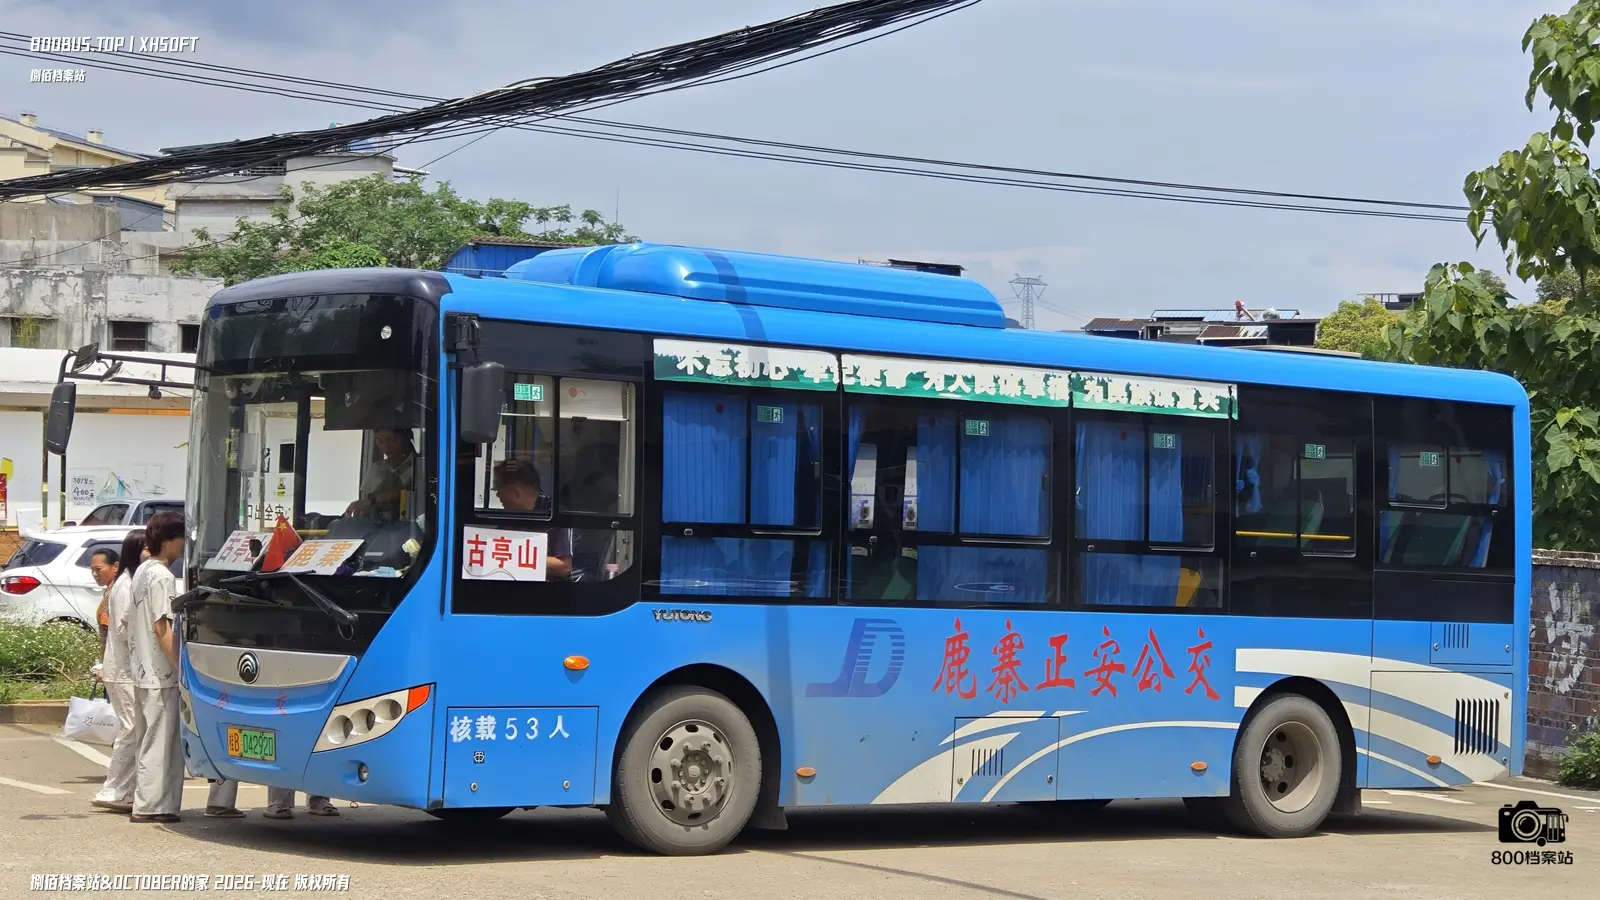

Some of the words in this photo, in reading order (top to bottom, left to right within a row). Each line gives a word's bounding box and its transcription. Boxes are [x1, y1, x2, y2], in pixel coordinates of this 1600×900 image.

[467, 534, 537, 570] 古亭山
[652, 609, 712, 623] YUTONG
[931, 616, 1221, 704] 鹿寨正安公交
